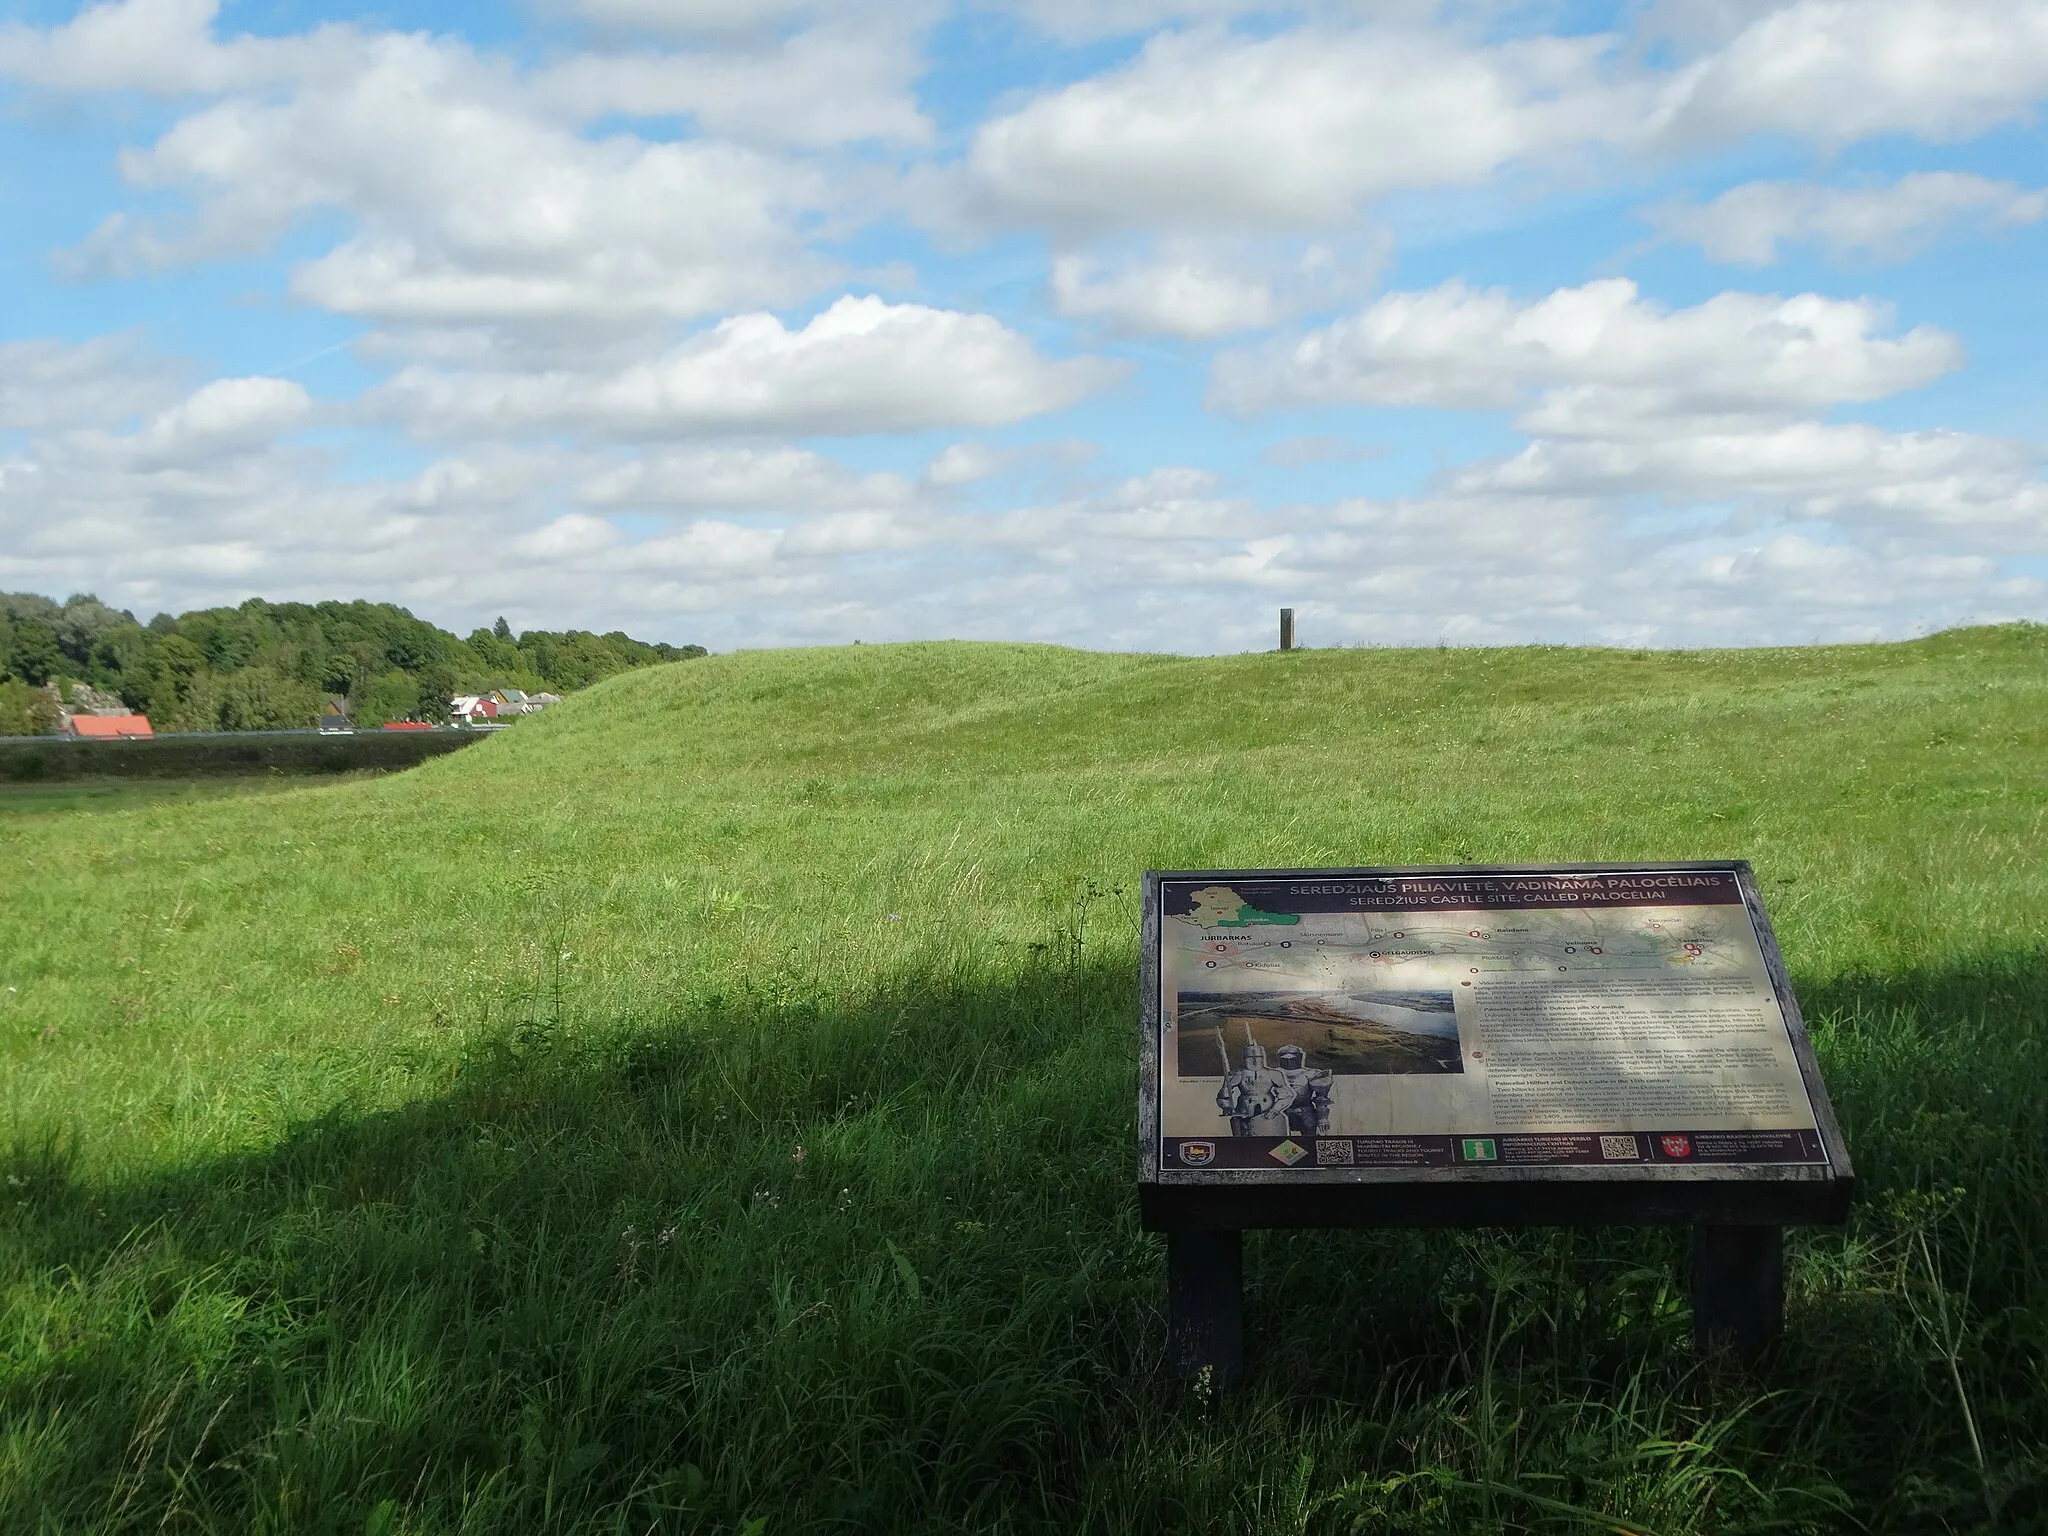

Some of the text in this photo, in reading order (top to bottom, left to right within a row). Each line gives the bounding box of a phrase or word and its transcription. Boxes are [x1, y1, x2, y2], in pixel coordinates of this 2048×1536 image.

[1290, 876, 1721, 895] SEREDŽIAUS PILIAVIETĖ, VADINAMA PALOCĖLIAIS
[1350, 894, 1427, 906] SEREDŽIUS
[1430, 895, 1484, 904] CASTLE
[1523, 892, 1580, 902] CALLED
